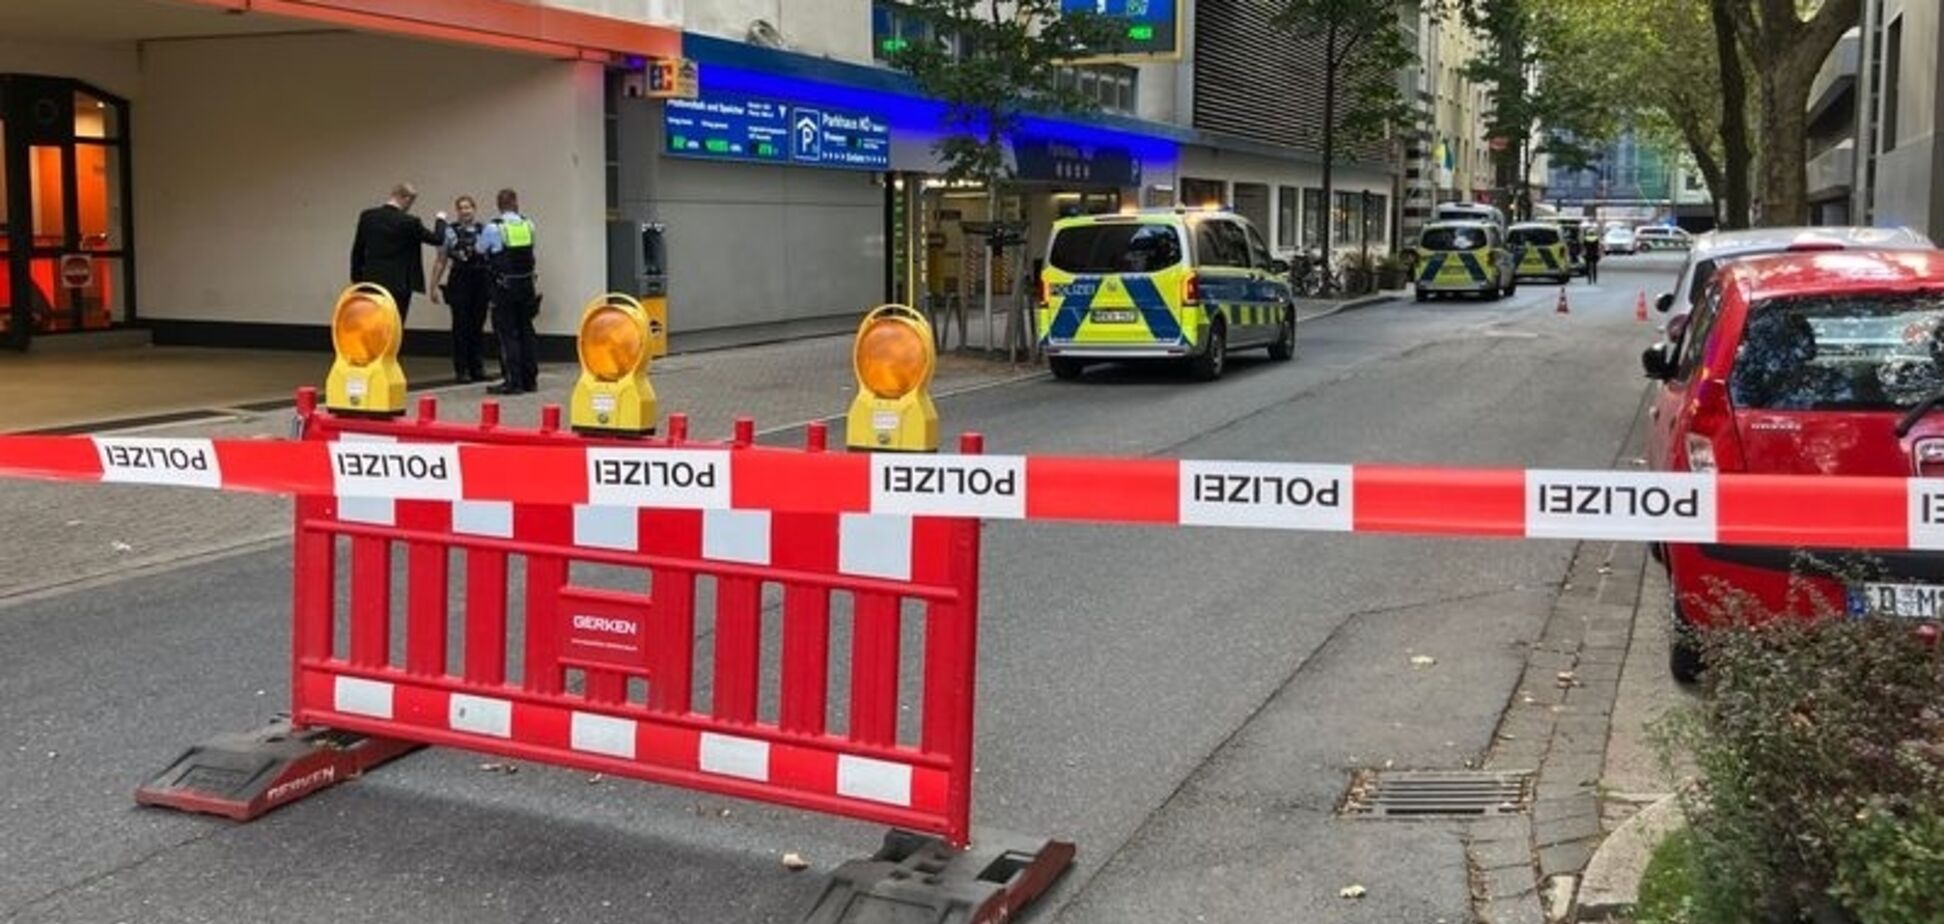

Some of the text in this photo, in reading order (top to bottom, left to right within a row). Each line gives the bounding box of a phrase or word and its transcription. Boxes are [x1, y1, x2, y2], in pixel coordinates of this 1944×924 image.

[106, 447, 207, 470] POLIZEI
[337, 453, 447, 479] POLIZEI
[595, 460, 715, 488] POLIZEI
[884, 466, 1015, 496] POLIZEI
[1194, 474, 1339, 507] POLIZEI
[1539, 484, 1698, 517] POLIZEI
[573, 614, 637, 635] GERKEN
